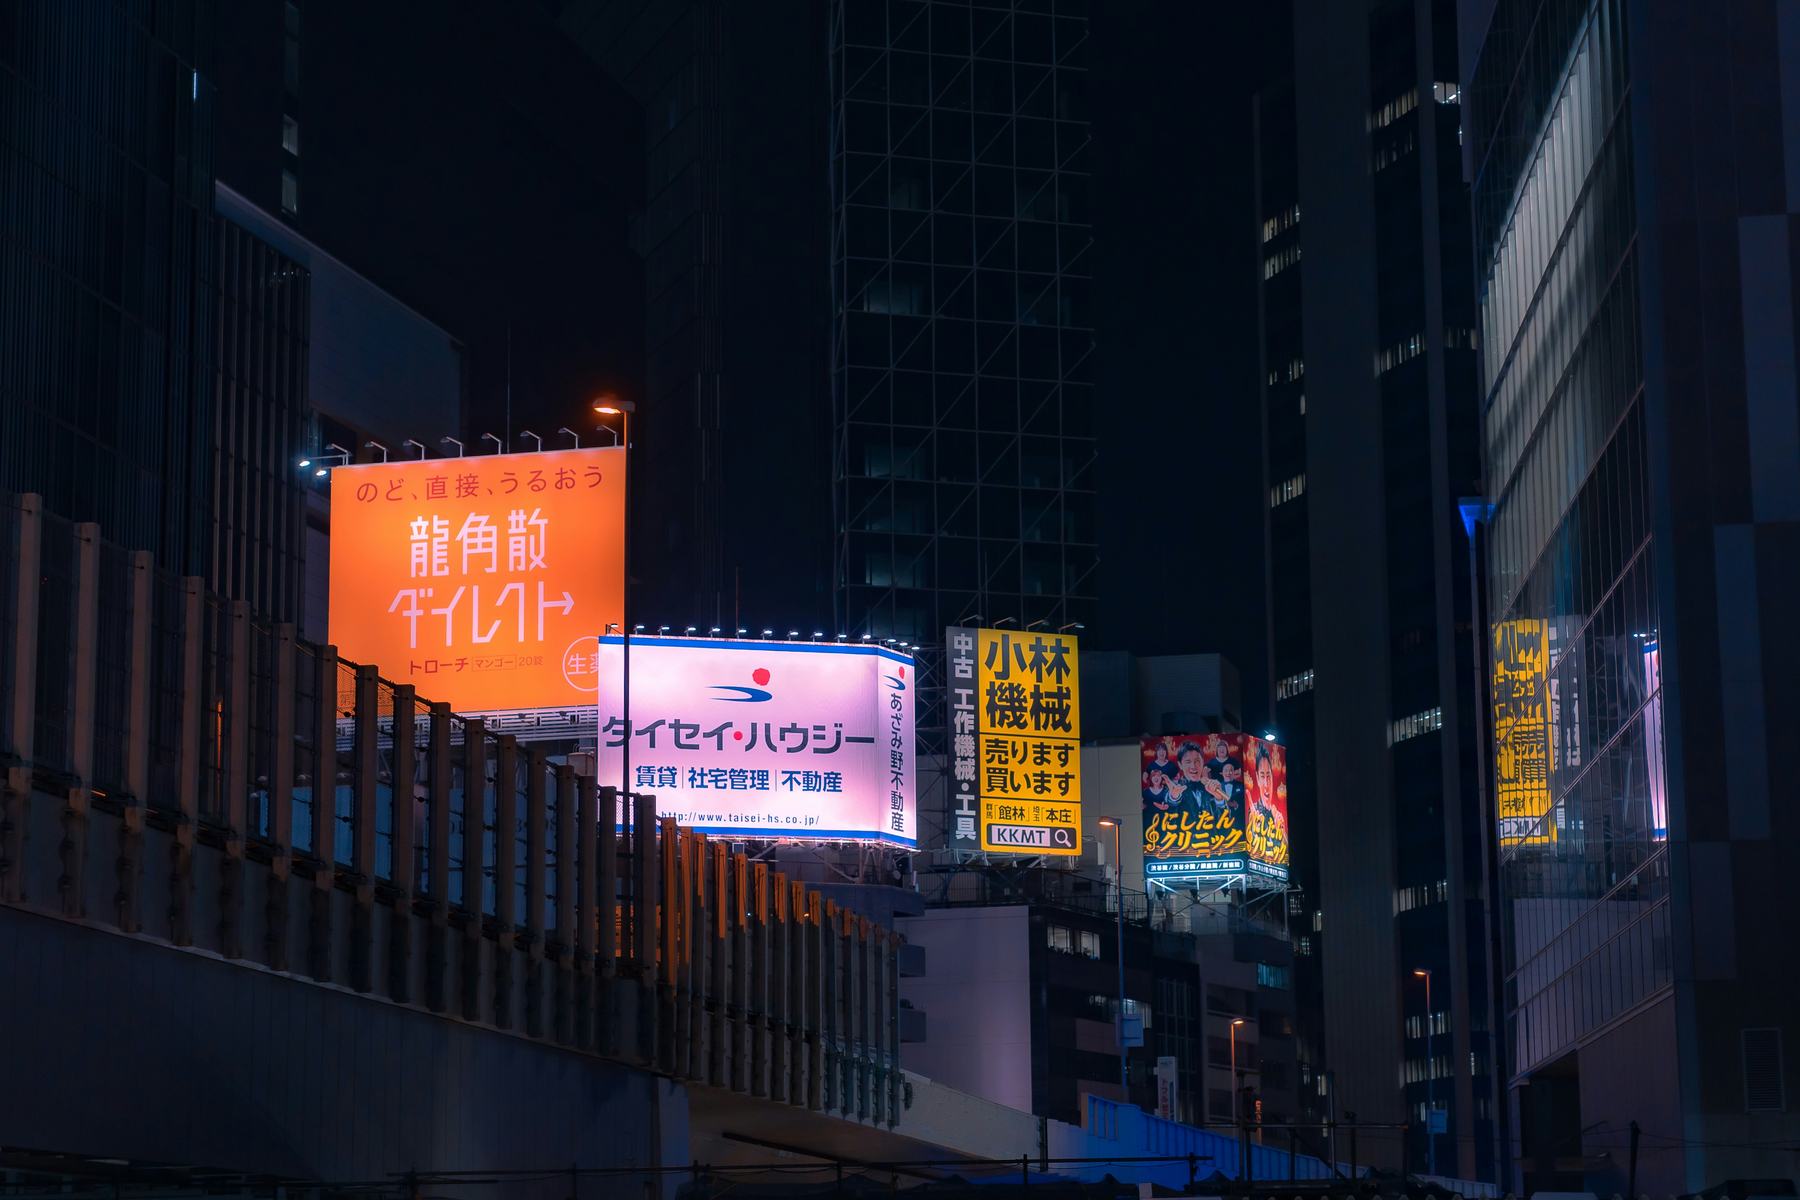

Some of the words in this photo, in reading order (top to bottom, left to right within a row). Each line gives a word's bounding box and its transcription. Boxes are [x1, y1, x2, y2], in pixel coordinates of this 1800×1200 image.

[357, 466, 603, 503] のど、直接、うるおう
[409, 508, 549, 578] 龍角散
[387, 581, 575, 649] ダイレクト
[410, 657, 469, 675] トローチ
[953, 633, 973, 679] 中古
[985, 634, 1071, 684] 小林
[986, 681, 1072, 733] 機械
[602, 715, 875, 754] タイセイ・ハウジー
[890, 693, 905, 833] あざみ野不動産
[985, 738, 1075, 768] 売ります
[635, 765, 677, 789] 賃貸
[688, 767, 769, 791] 社宅管理
[782, 770, 843, 793] 不動産
[986, 767, 1075, 797] 買います
[661, 811, 820, 825] http://www.taisei-hs.co.jp/
[1161, 809, 1234, 831] にしたん
[997, 828, 1045, 844] KKMT
[1161, 827, 1244, 852] クリニック
